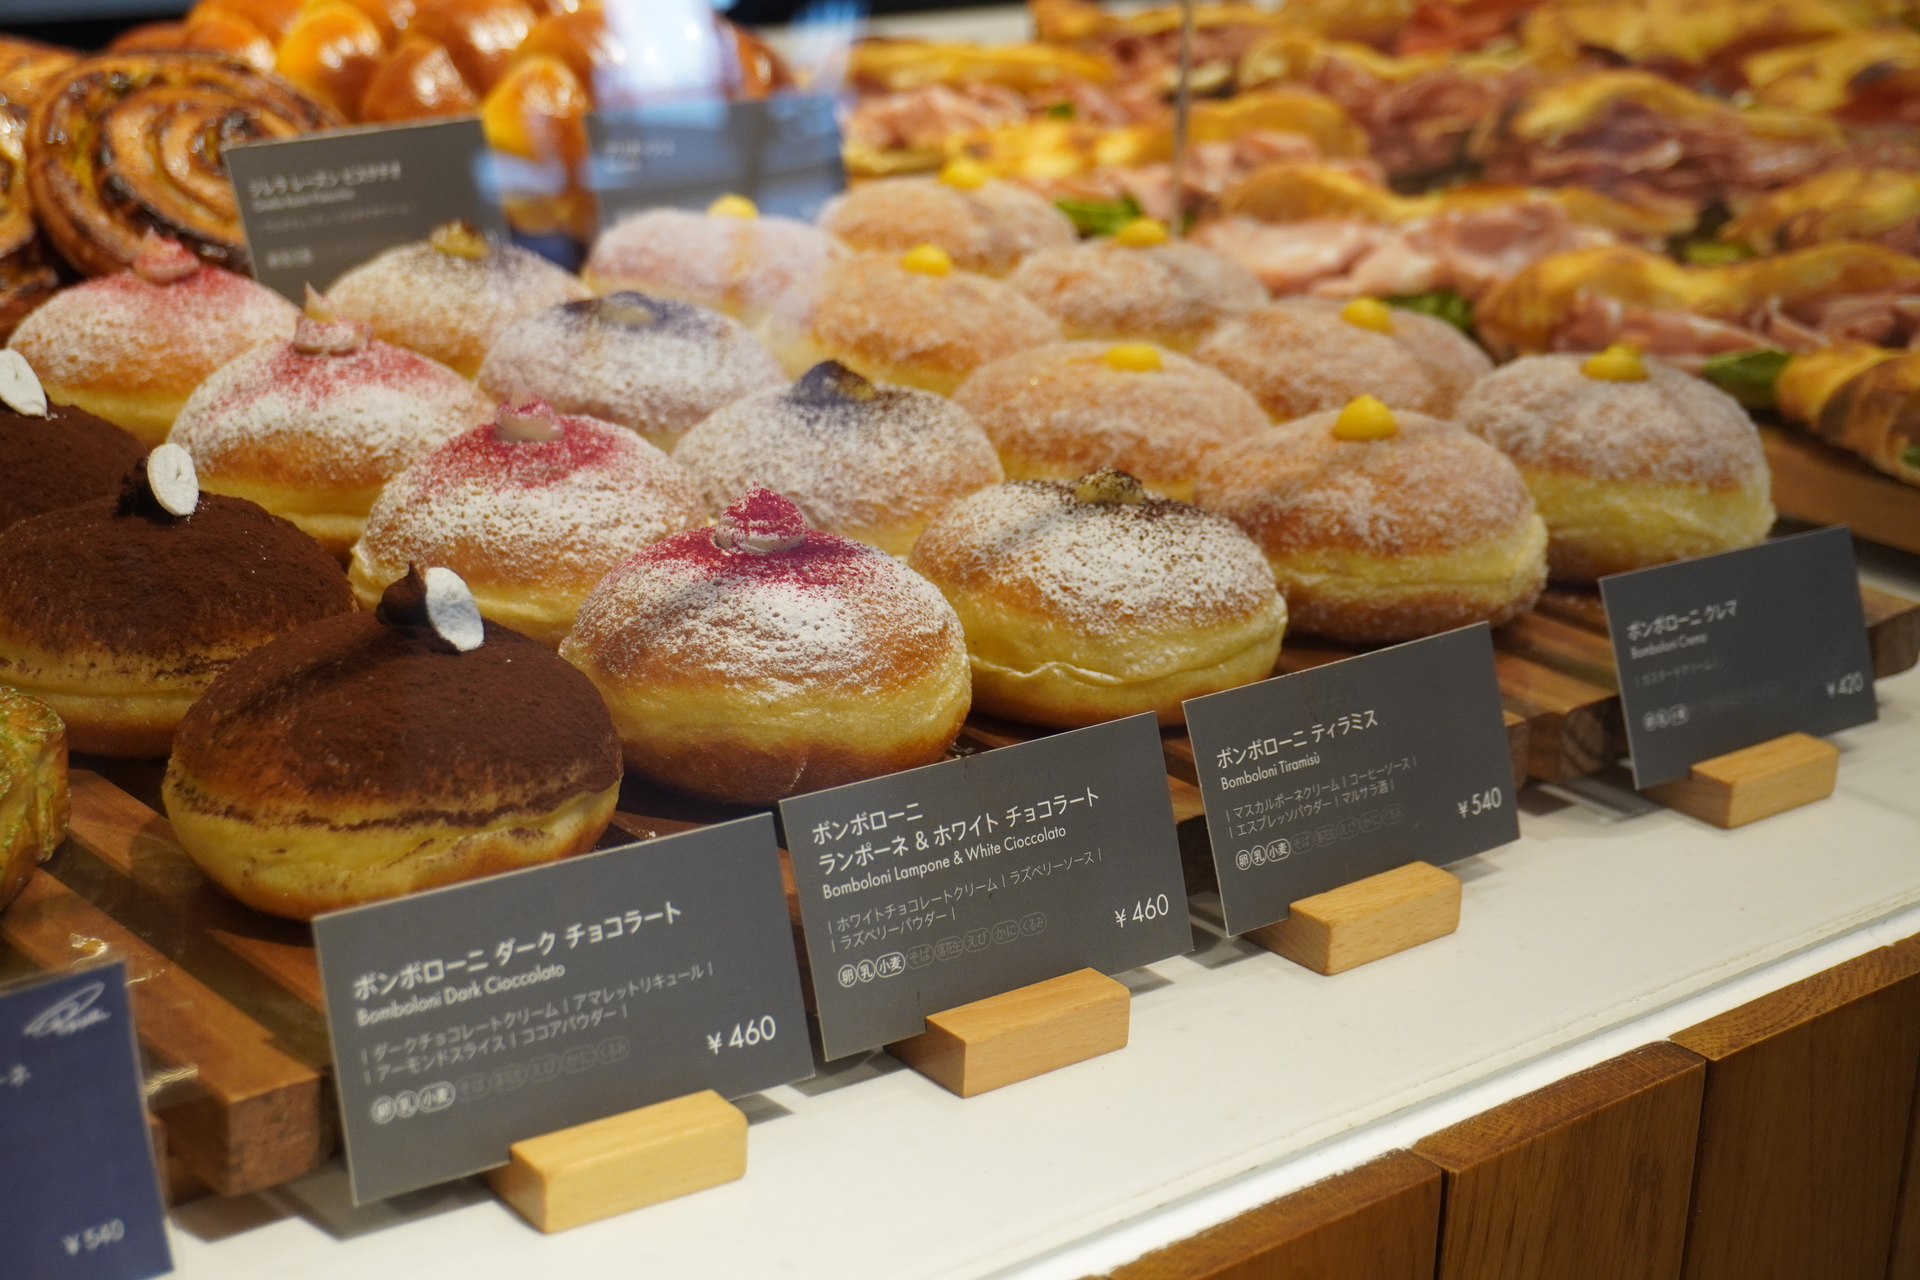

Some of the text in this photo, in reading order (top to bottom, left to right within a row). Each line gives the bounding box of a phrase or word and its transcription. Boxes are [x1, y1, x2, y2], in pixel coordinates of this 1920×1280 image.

[1703, 599, 1738, 623] クレマ
[1216, 710, 1378, 769] ボンボローニ ティラミス
[1220, 752, 1321, 791] Bomboloni Tiramisù
[812, 802, 923, 845] ボンボローニ
[819, 787, 1099, 875] ランポーネ & ホワイト チョコラート
[822, 826, 1066, 899] Bomboloni Lampone & White Cioccolato
[354, 901, 682, 1001] ボンボローニ ダーク チョコラート
[357, 963, 565, 1027] Bomboloni Dark Cioccolato
